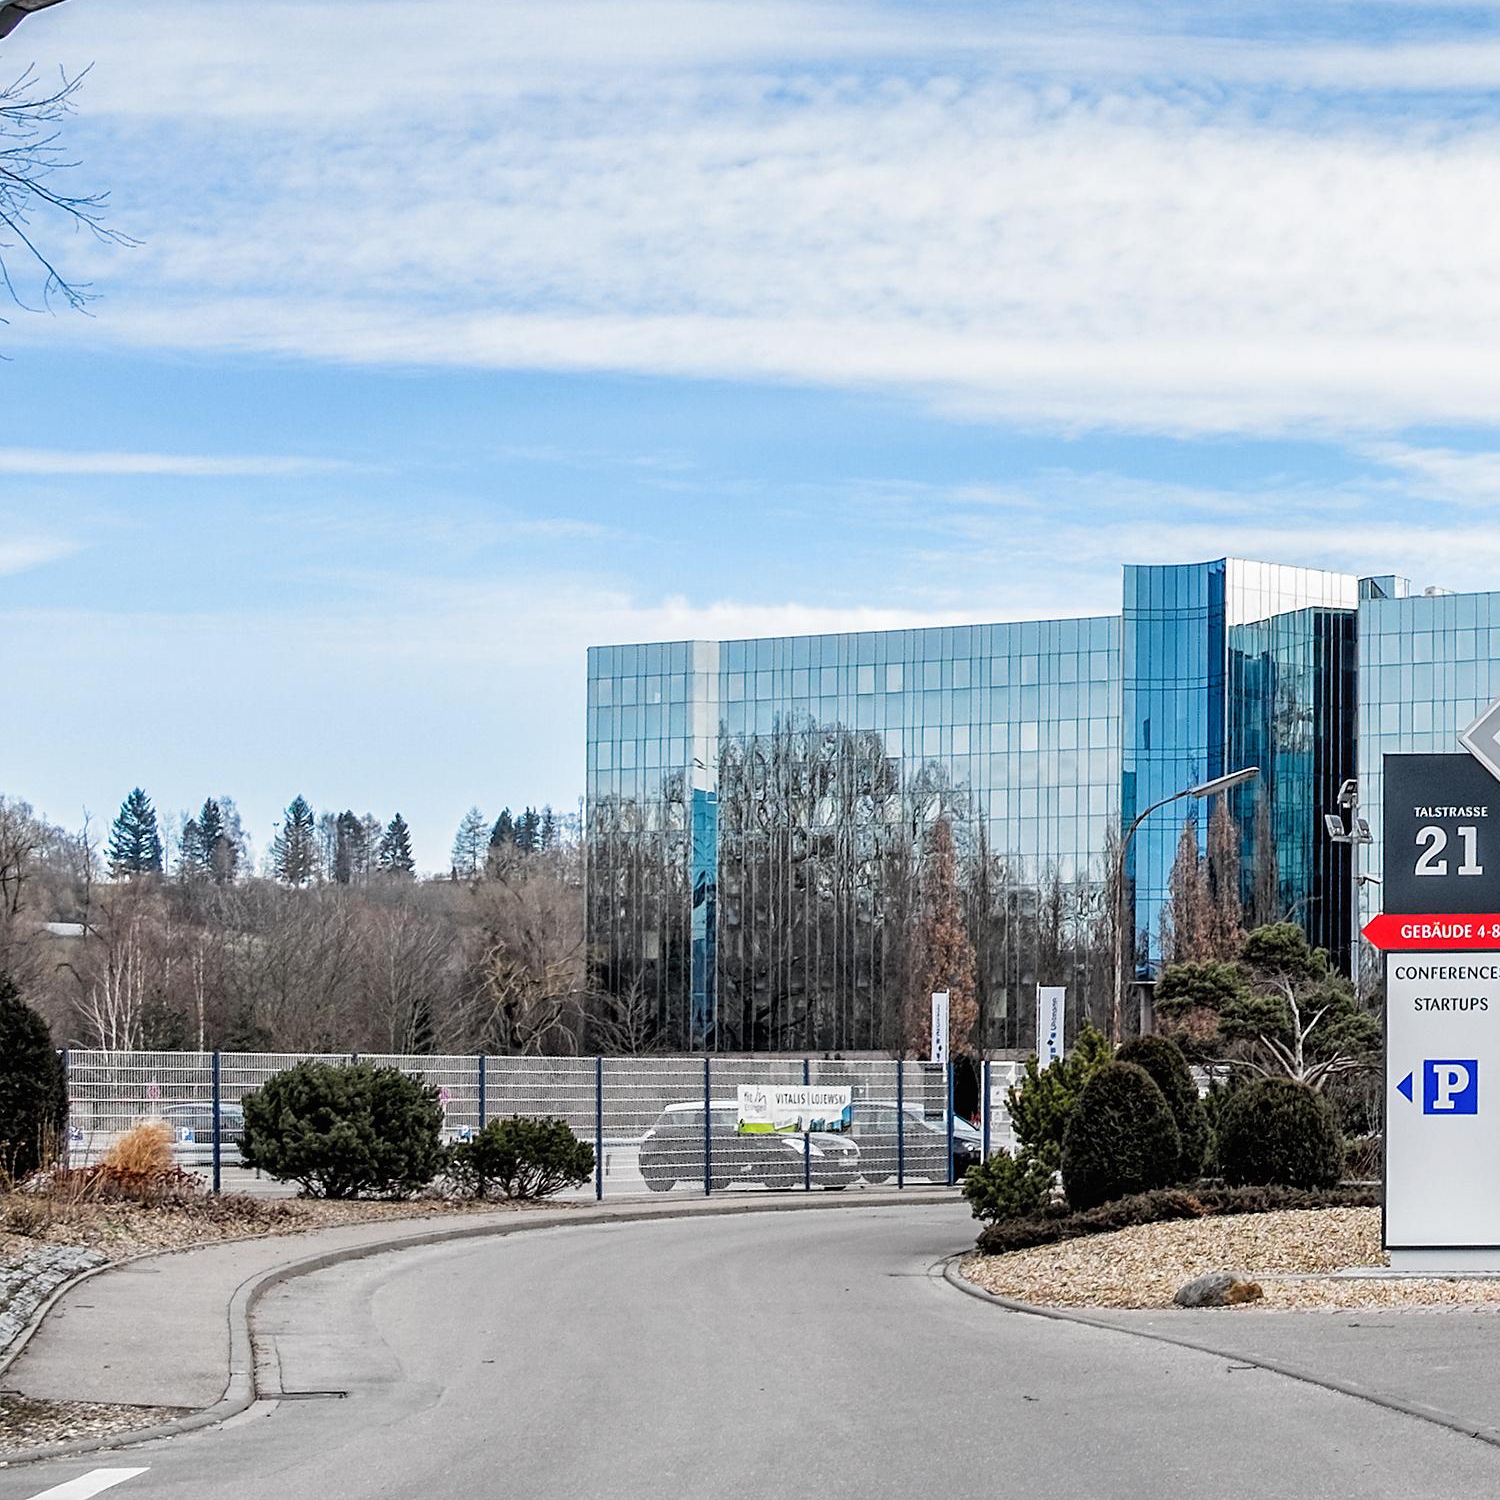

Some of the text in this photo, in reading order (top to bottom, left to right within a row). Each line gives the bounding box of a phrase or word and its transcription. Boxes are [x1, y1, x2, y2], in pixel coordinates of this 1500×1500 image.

[1414, 806, 1488, 818] TALSTRASSE
[1414, 825, 1484, 876] 21
[1400, 921, 1500, 939] GEBÄUDE 4-8
[1414, 997, 1489, 1012] STARTUPS
[1432, 1064, 1470, 1109] P
